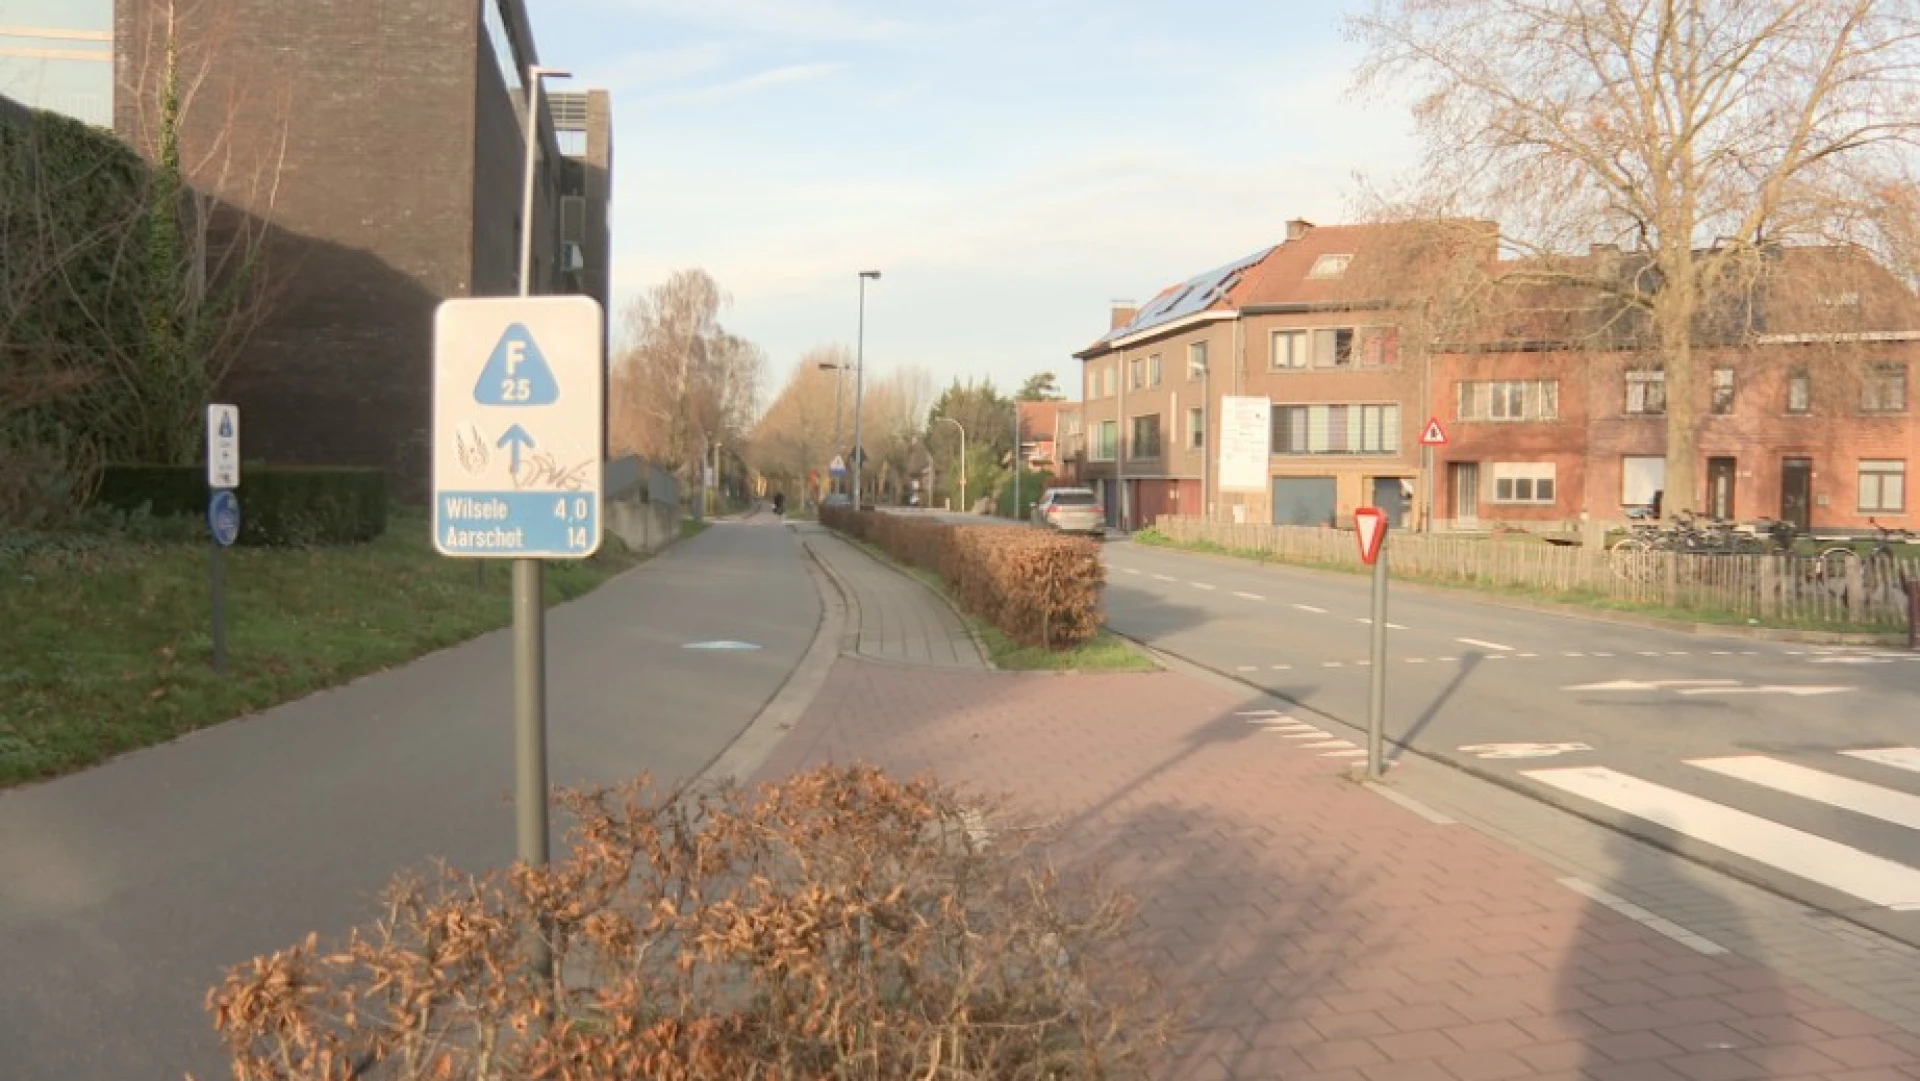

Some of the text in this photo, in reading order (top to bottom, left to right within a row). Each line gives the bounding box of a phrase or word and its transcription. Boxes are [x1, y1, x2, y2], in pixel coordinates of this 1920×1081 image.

[506, 341, 527, 375] F
[502, 378, 531, 401] 25
[448, 498, 509, 519] Wilsele
[448, 526, 587, 547] Aarschot 14
